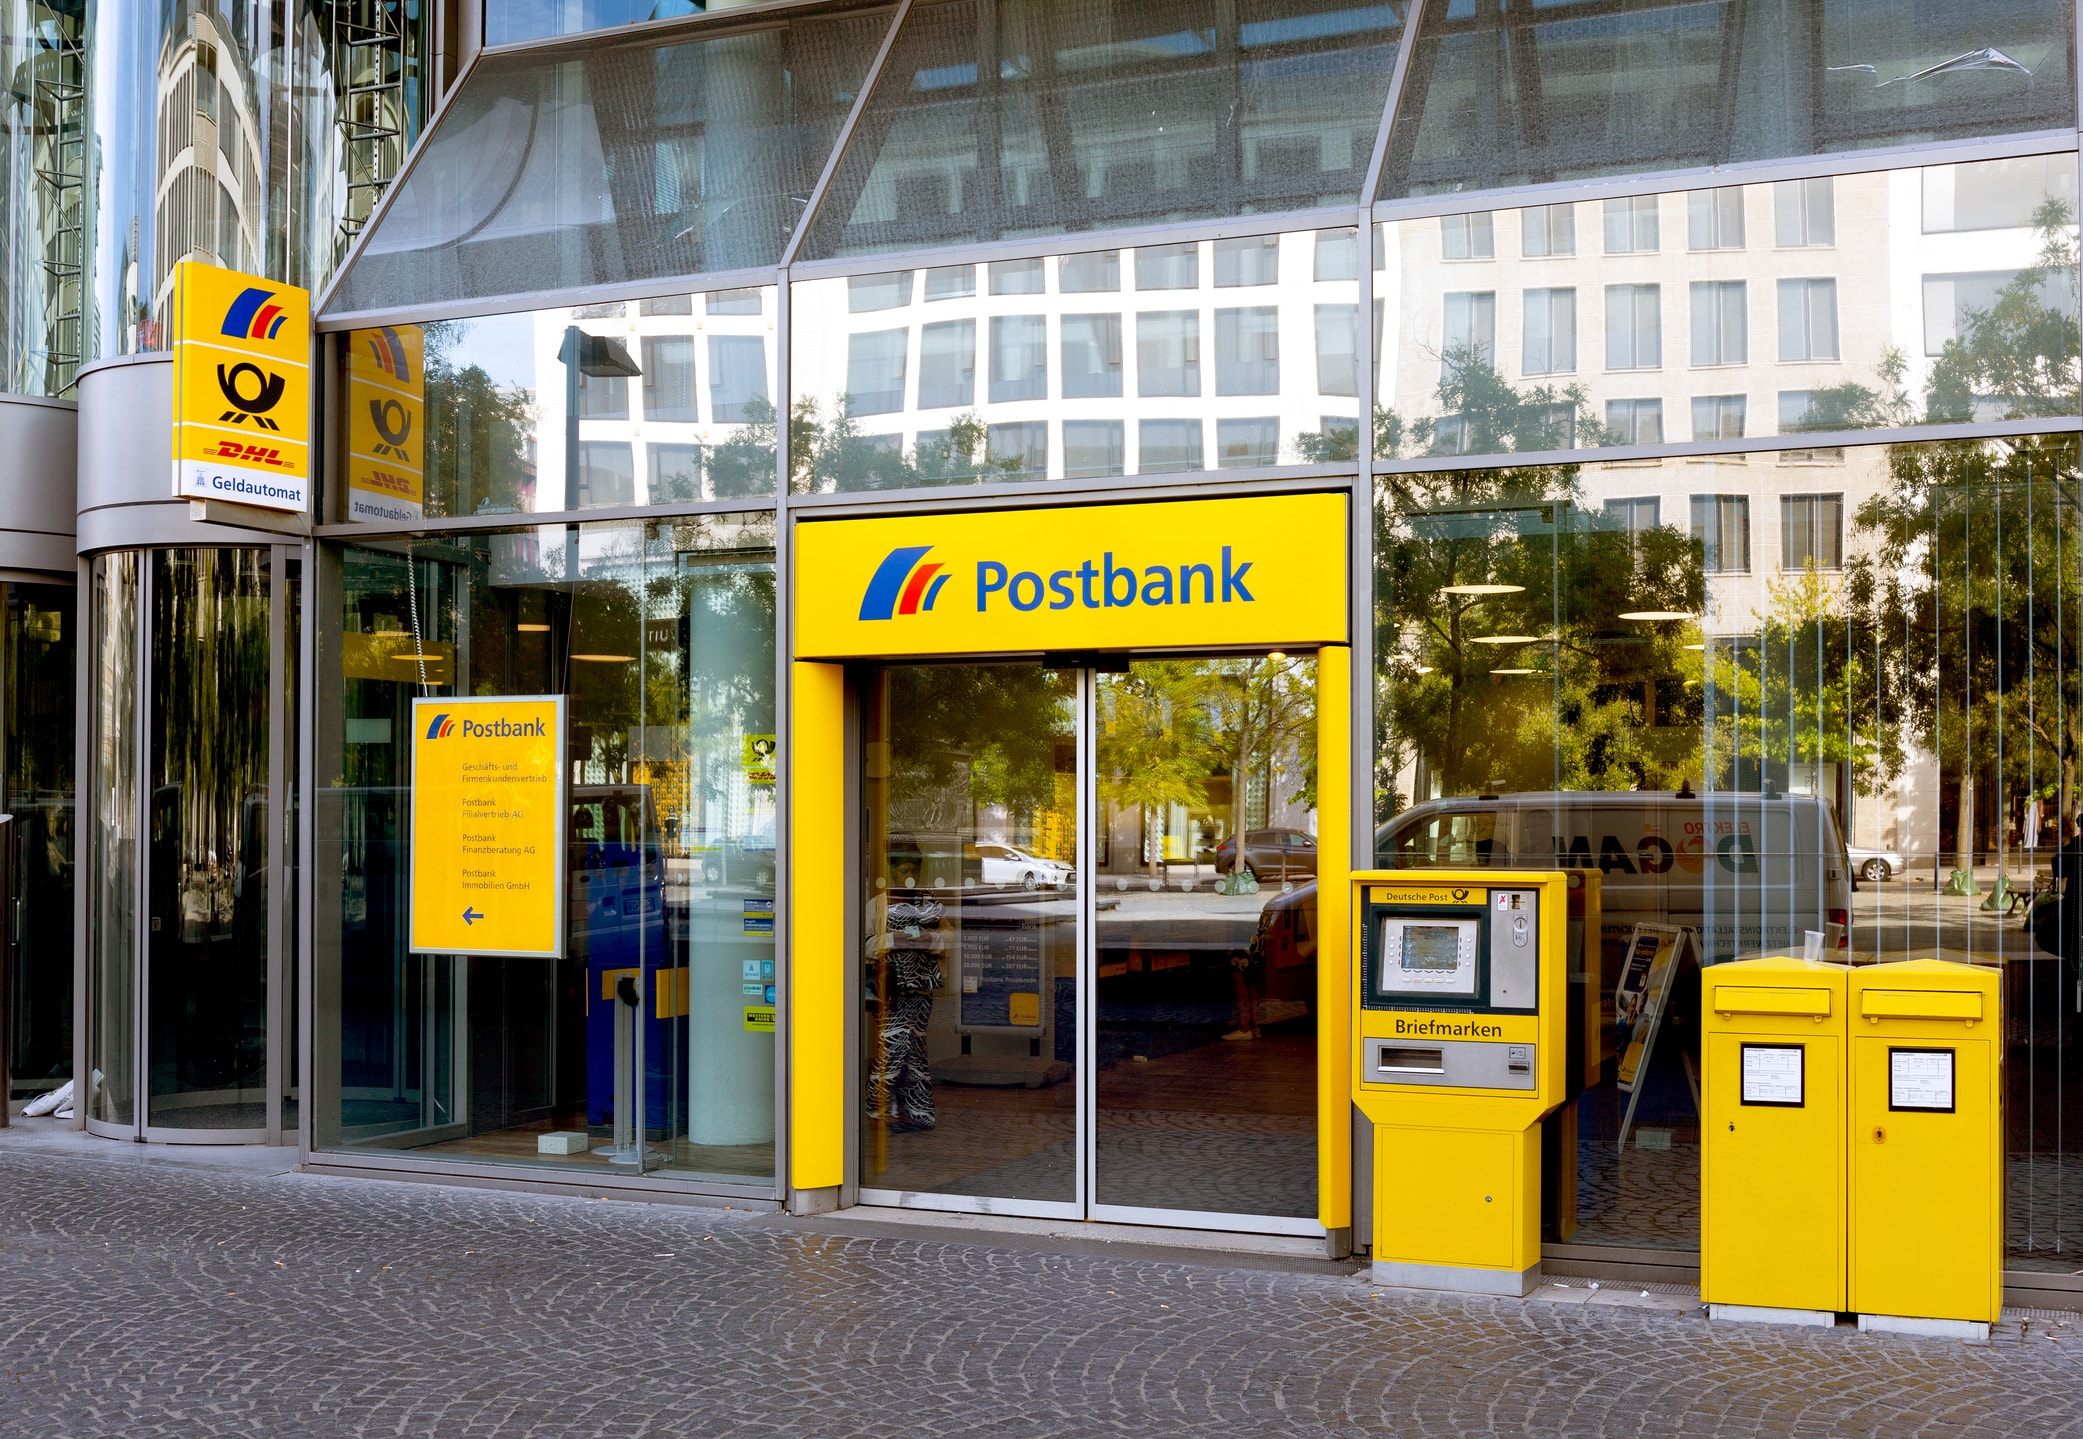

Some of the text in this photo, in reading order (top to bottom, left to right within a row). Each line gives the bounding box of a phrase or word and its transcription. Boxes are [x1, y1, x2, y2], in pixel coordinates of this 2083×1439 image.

[216, 440, 284, 467] DHL
[212, 475, 302, 502] Geldautomat
[976, 545, 1256, 613] Postbank
[463, 717, 546, 738] Postbank
[462, 762, 518, 771] Geschäfts- und
[462, 774, 548, 783] Firmenkundenvertrieb
[462, 798, 497, 807] Postbank
[462, 810, 524, 819] Filialvertrieb AG
[462, 833, 497, 842] Postbank
[462, 845, 536, 856] Finanzberatung AG
[462, 869, 497, 878] Postbank
[462, 881, 531, 890] Immobilien GmbH
[1386, 892, 1449, 902] Deutsche Post
[1395, 1019, 1503, 1038] Briefmarken
